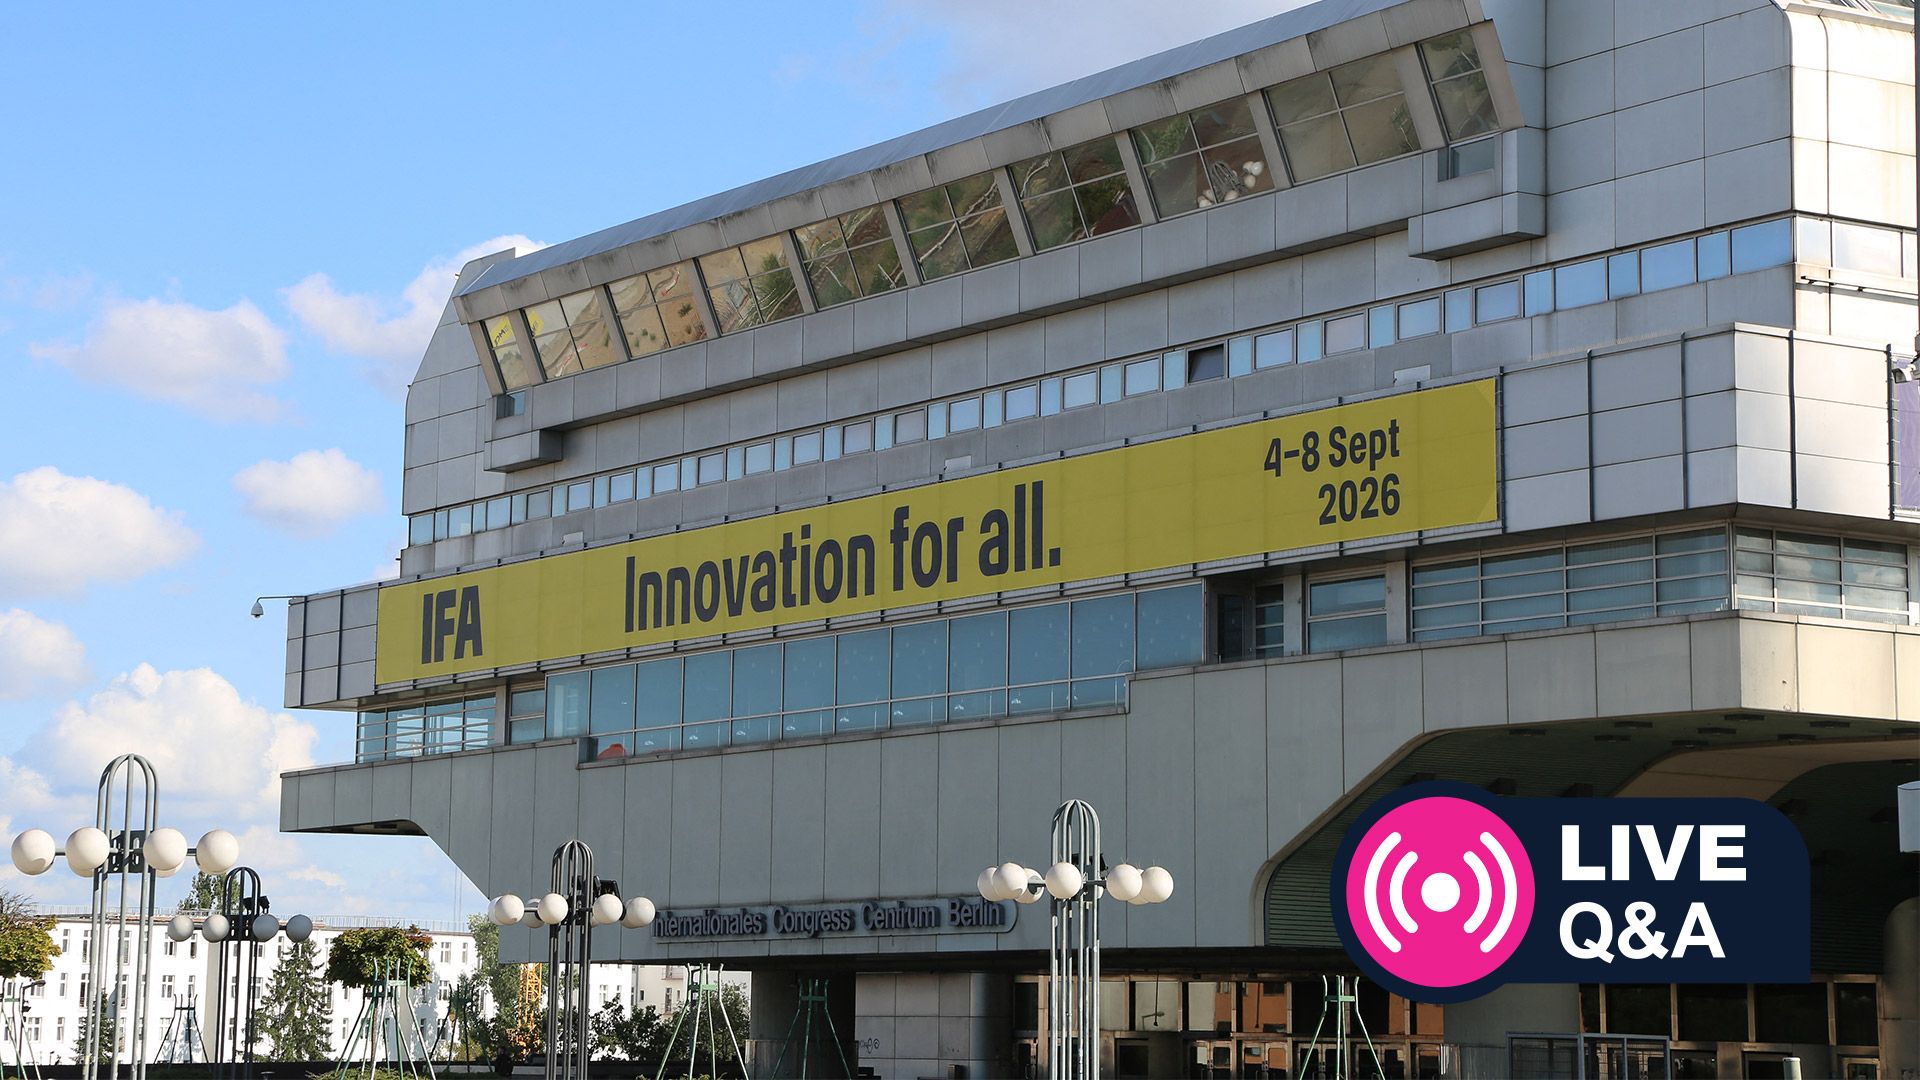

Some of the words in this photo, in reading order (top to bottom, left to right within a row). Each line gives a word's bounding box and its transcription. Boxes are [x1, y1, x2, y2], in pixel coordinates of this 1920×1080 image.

[1328, 418, 1401, 472] Sept
[1317, 472, 1401, 527] 2026
[625, 523, 876, 634] Innovation
[890, 504, 965, 592] for
[979, 479, 1062, 577] all.
[421, 584, 484, 665] IFA
[771, 905, 854, 938] Congress
[859, 902, 939, 932] Centrum
[949, 899, 1003, 926] Berlin
